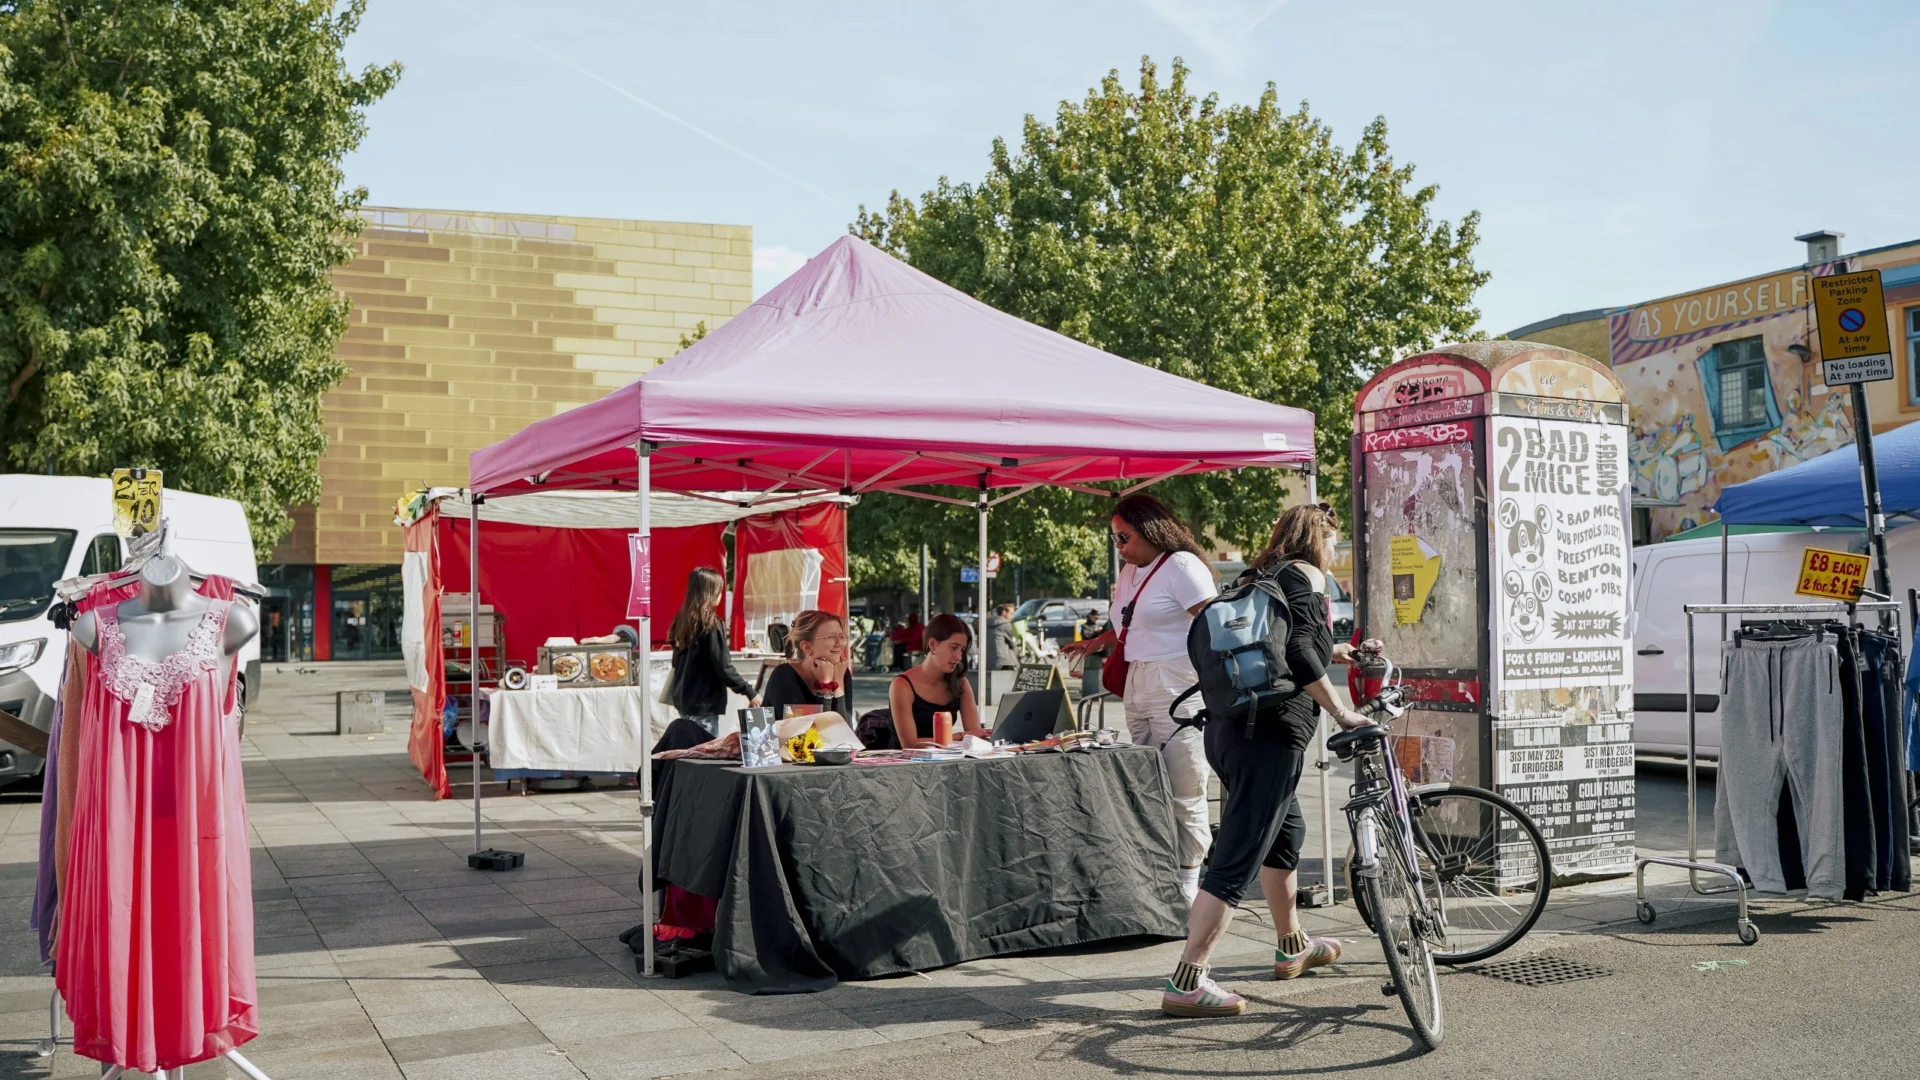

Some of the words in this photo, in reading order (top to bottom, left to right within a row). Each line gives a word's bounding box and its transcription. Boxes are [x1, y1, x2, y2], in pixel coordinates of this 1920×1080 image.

[1821, 274, 1873, 288] Restricted
[1829, 286, 1867, 297] Parking
[1636, 306, 1662, 338] AS
[1673, 275, 1807, 331] YOURSELF
[1837, 297, 1862, 306] Zone
[1838, 336, 1850, 344] At
[1853, 334, 1871, 343] any
[1844, 344, 1867, 353] time
[1830, 363, 1845, 371] No
[1848, 359, 1885, 369] loading
[1829, 373, 1841, 381] At
[1844, 371, 1862, 380] any
[1866, 368, 1888, 377] time
[1556, 404, 1565, 417] &
[1497, 426, 1522, 492] 2
[1524, 427, 1589, 463] BAD
[1595, 444, 1619, 496] FRIENDS
[1524, 460, 1591, 496] MICE
[115, 476, 135, 500] 2
[1556, 509, 1564, 524] 2
[1567, 510, 1590, 526] BAD
[1593, 504, 1620, 521] MICE
[1556, 528, 1572, 545] DUB
[1573, 525, 1602, 545] PISTOLS
[1557, 543, 1621, 565] FREESTYLERS
[1809, 552, 1829, 572] £8
[1832, 561, 1862, 576] EACH
[1557, 562, 1621, 585] BENTON
[1558, 587, 1592, 605] COSMO
[1601, 582, 1622, 597] DIBS
[1803, 578, 1810, 590] 2
[1812, 578, 1827, 592] for
[1829, 576, 1860, 596] £15
[1563, 619, 1576, 631] SAT
[1578, 619, 1591, 630] 21ST
[1593, 618, 1611, 630] SEPT
[1505, 652, 1525, 665] FOX
[1535, 651, 1565, 664] FIRKIN
[1573, 649, 1621, 663] LEWISHAM
[1506, 667, 1530, 676] ALL
[1533, 666, 1579, 676] THINGS
[1513, 727, 1561, 747] GLAM
[1510, 751, 1526, 762] 31ST
[1527, 750, 1544, 761] MAY
[1545, 749, 1563, 760] 2024
[1584, 747, 1598, 758] 31ST
[1600, 746, 1614, 757] MAY
[1616, 745, 1633, 756] 2024
[1512, 763, 1520, 774] AT
[1522, 761, 1563, 774] BRIDGEBAR
[1585, 759, 1593, 769] AT
[1595, 757, 1633, 769] BRIDGEBAR
[1503, 787, 1530, 804] COLIN
[1532, 784, 1568, 802] FRANCIS
[1579, 781, 1602, 798] COLIN
[1604, 780, 1635, 796] FRANCIS
[1552, 802, 1562, 813] MC
[1575, 799, 1597, 811] MELODY
